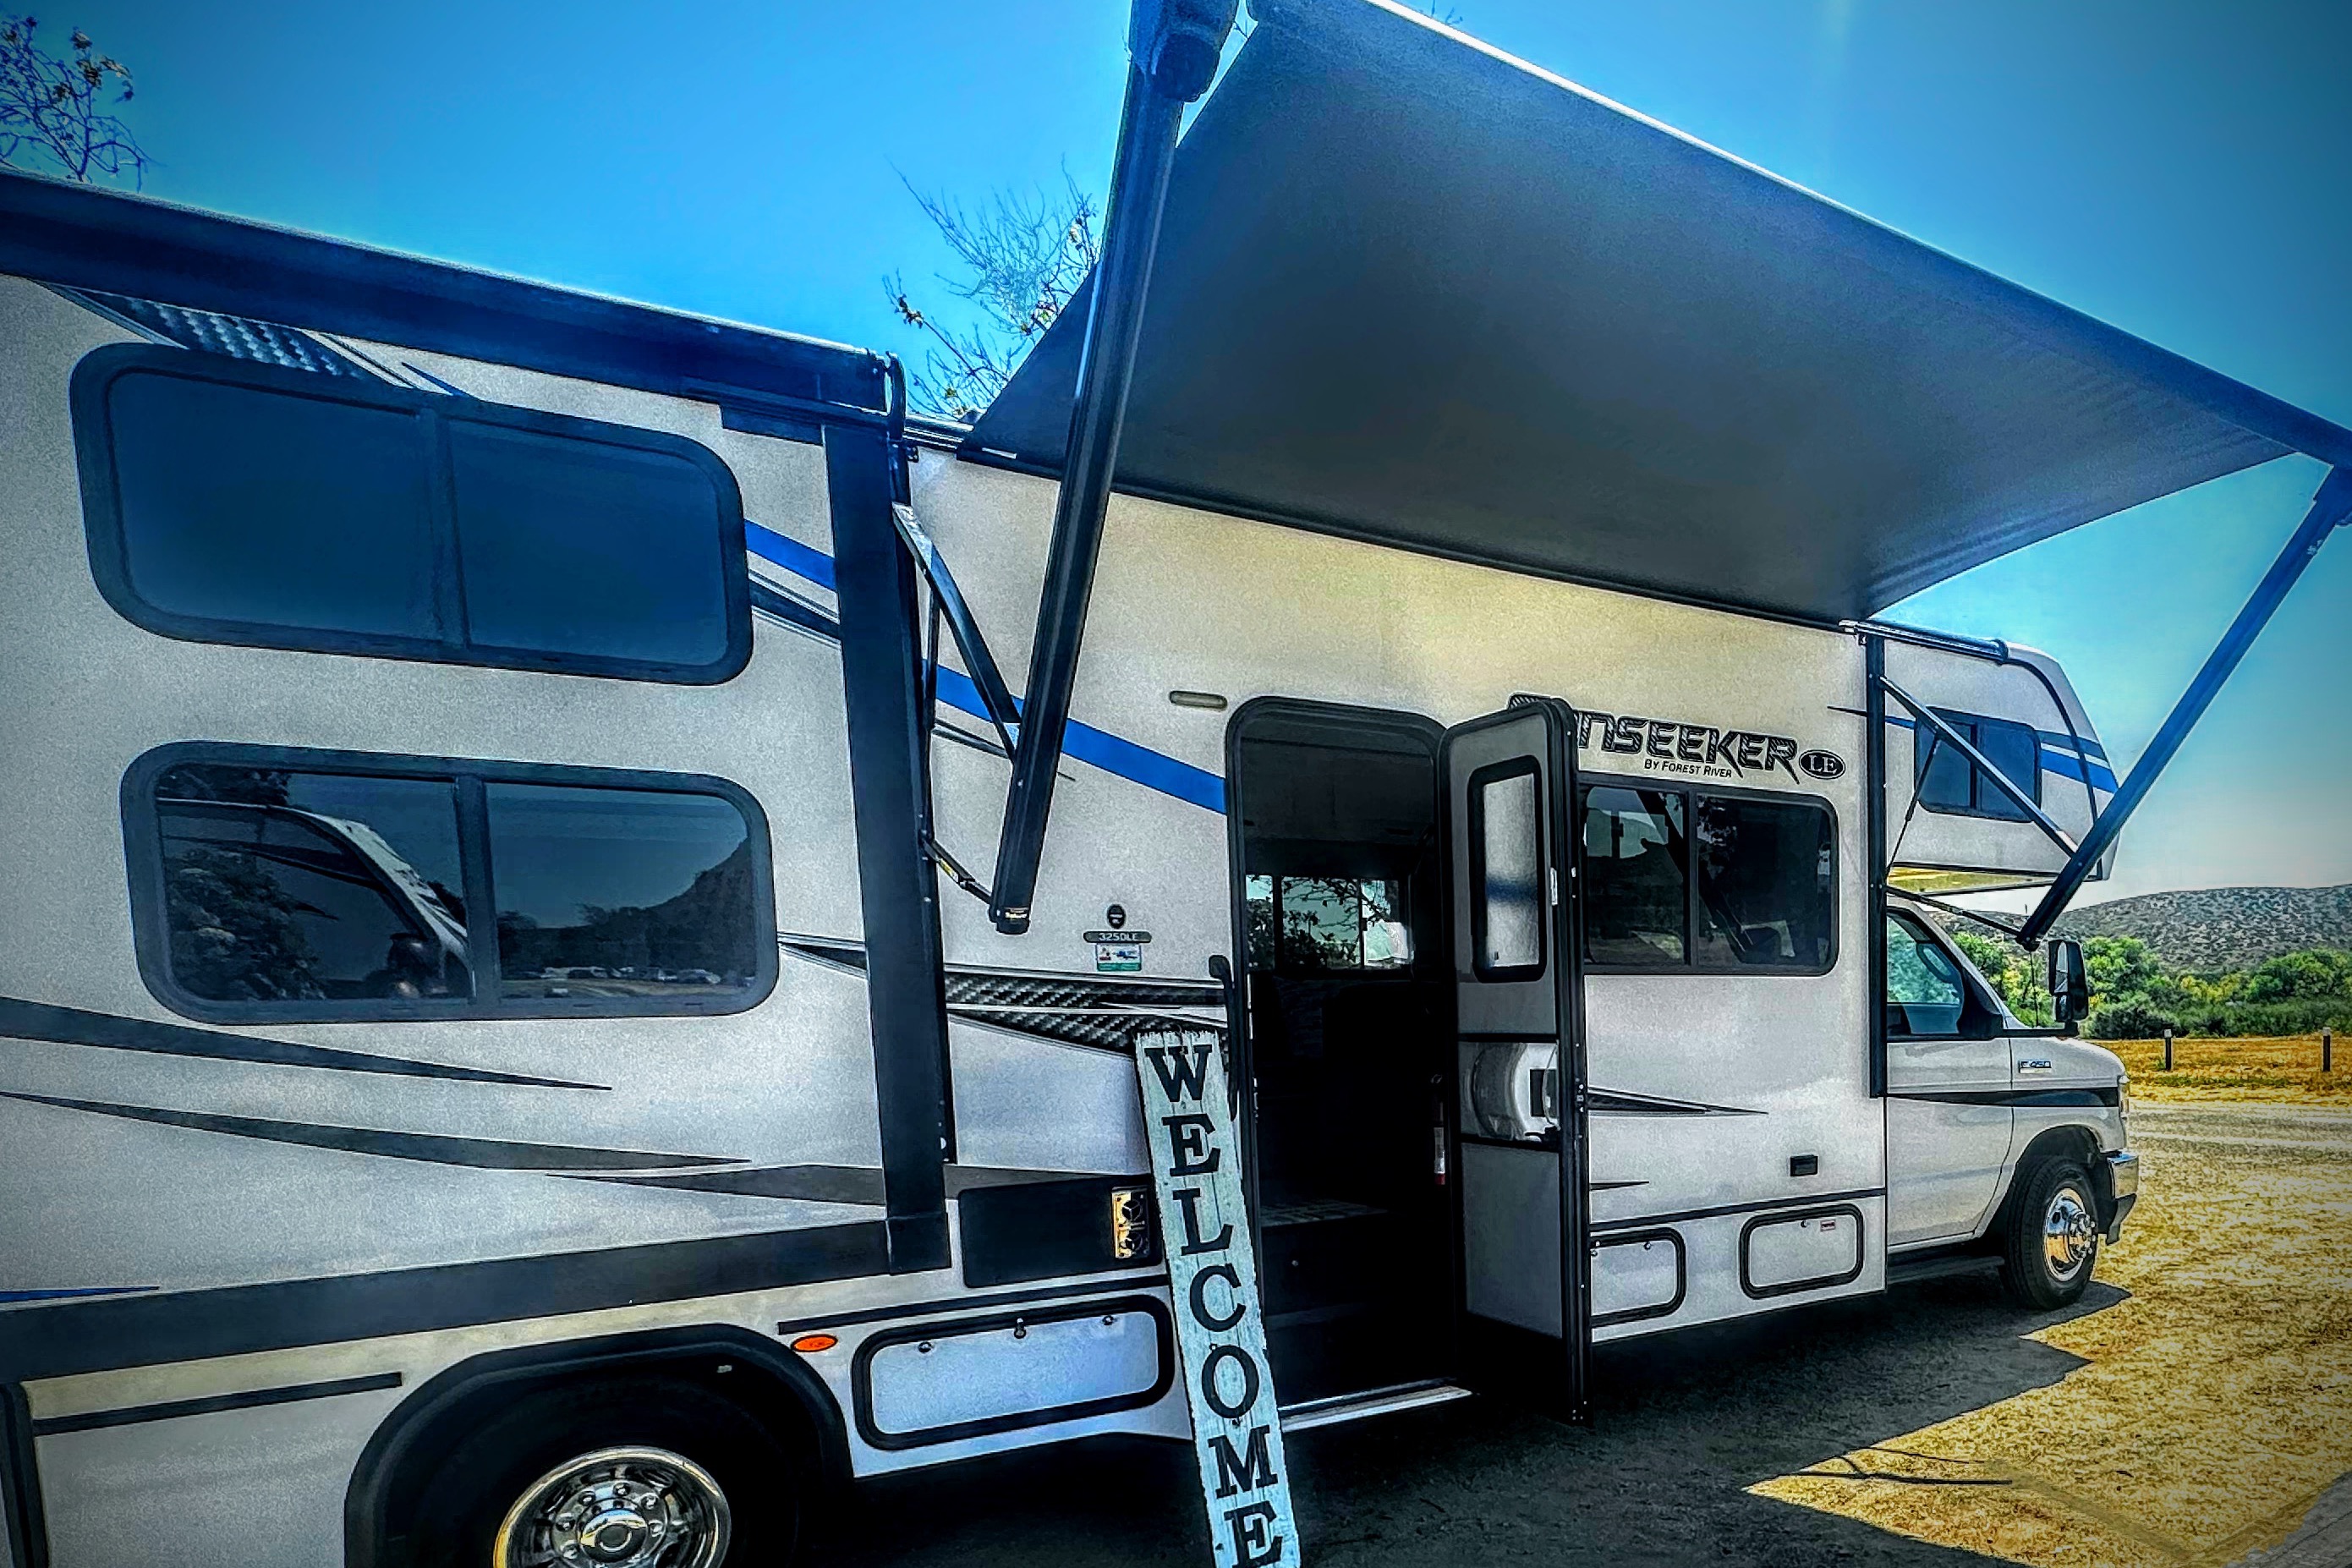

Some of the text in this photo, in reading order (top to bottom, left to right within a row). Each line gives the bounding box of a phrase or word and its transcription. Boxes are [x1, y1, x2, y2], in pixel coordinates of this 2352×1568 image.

[1509, 694, 1800, 785] NSEEKER
[1808, 754, 1838, 775] LE
[1644, 759, 1732, 778] BY FOREST RIVER
[1146, 1045, 1283, 1568] WELCOME
